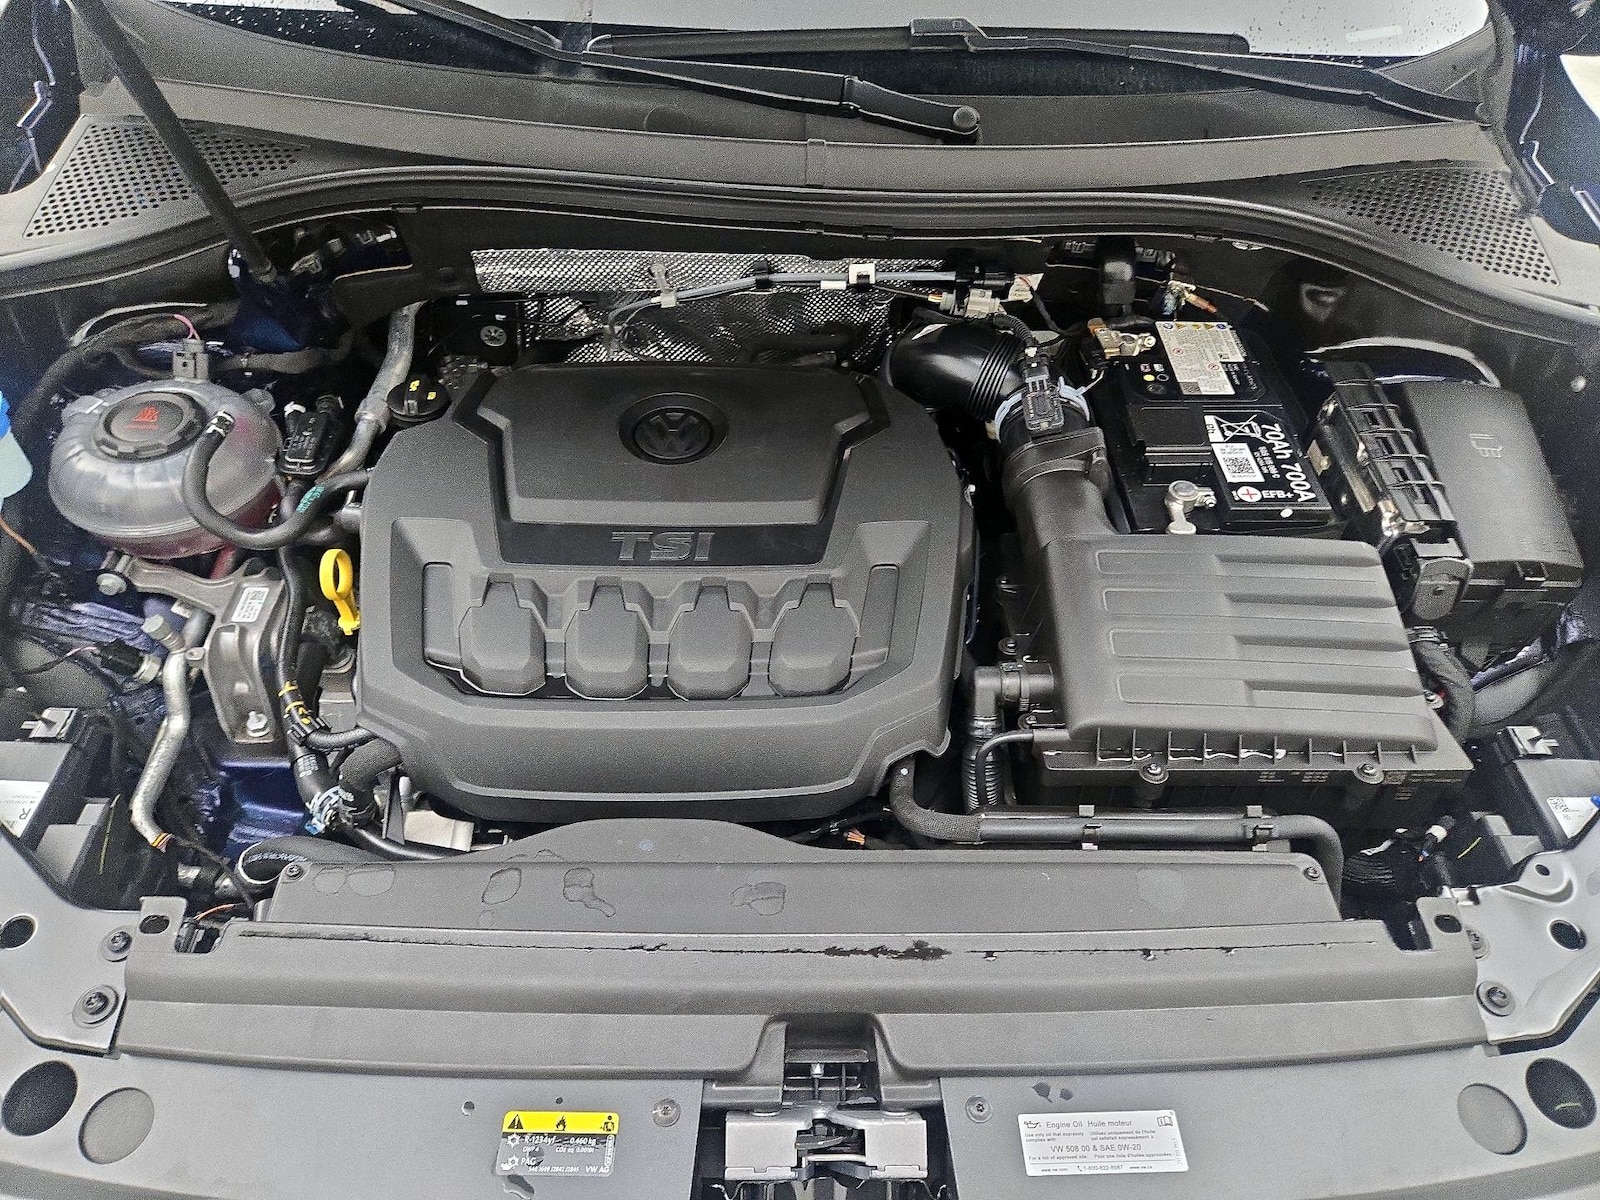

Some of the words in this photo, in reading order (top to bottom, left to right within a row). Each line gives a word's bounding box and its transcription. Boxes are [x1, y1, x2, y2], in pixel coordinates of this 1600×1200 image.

[1261, 423, 1293, 459] 70Ah
[1280, 462, 1316, 502] 700A
[1261, 490, 1294, 498] EFB+
[611, 531, 715, 561] TSI
[1046, 1121, 1071, 1129] Engine
[1073, 1120, 1082, 1128] Oil
[525, 1136, 556, 1145] R-1234yf
[1118, 1143, 1142, 1151] 0W-20
[521, 1157, 536, 1166] PAG
